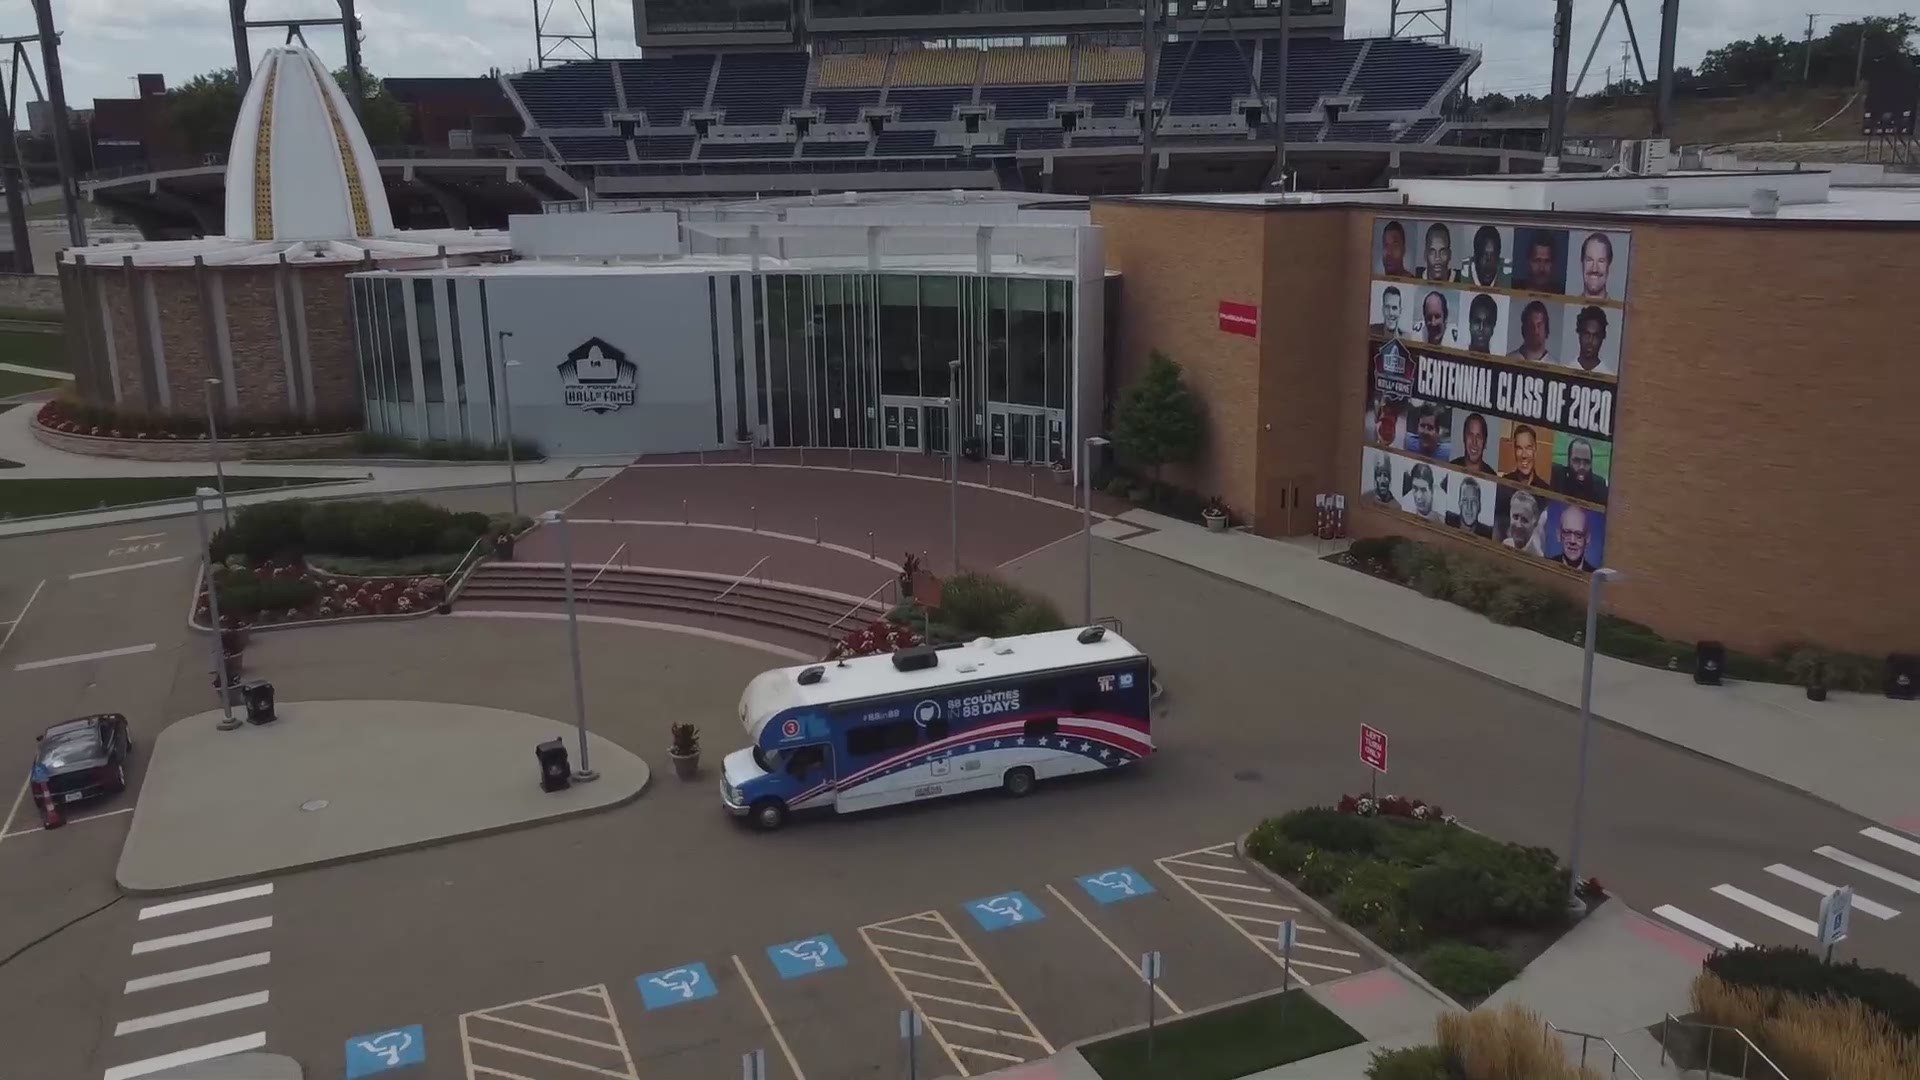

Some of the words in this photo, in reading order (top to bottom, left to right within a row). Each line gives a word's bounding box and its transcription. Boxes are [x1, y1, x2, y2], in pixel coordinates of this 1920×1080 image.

[568, 391, 596, 402] HALL
[604, 391, 631, 402] FAME
[1417, 354, 1493, 410] CENTENNIAL
[1496, 371, 1544, 420] CLASS
[1546, 380, 1566, 423] OF
[1568, 384, 1613, 436] 2020
[947, 699, 961, 709] 88
[963, 690, 1019, 706] COUNTIES
[947, 708, 960, 719] IN
[963, 705, 979, 718] 88
[982, 699, 1020, 715] DAYS
[1365, 730, 1381, 743] LEFT
[1365, 745, 1381, 759] ONLY
